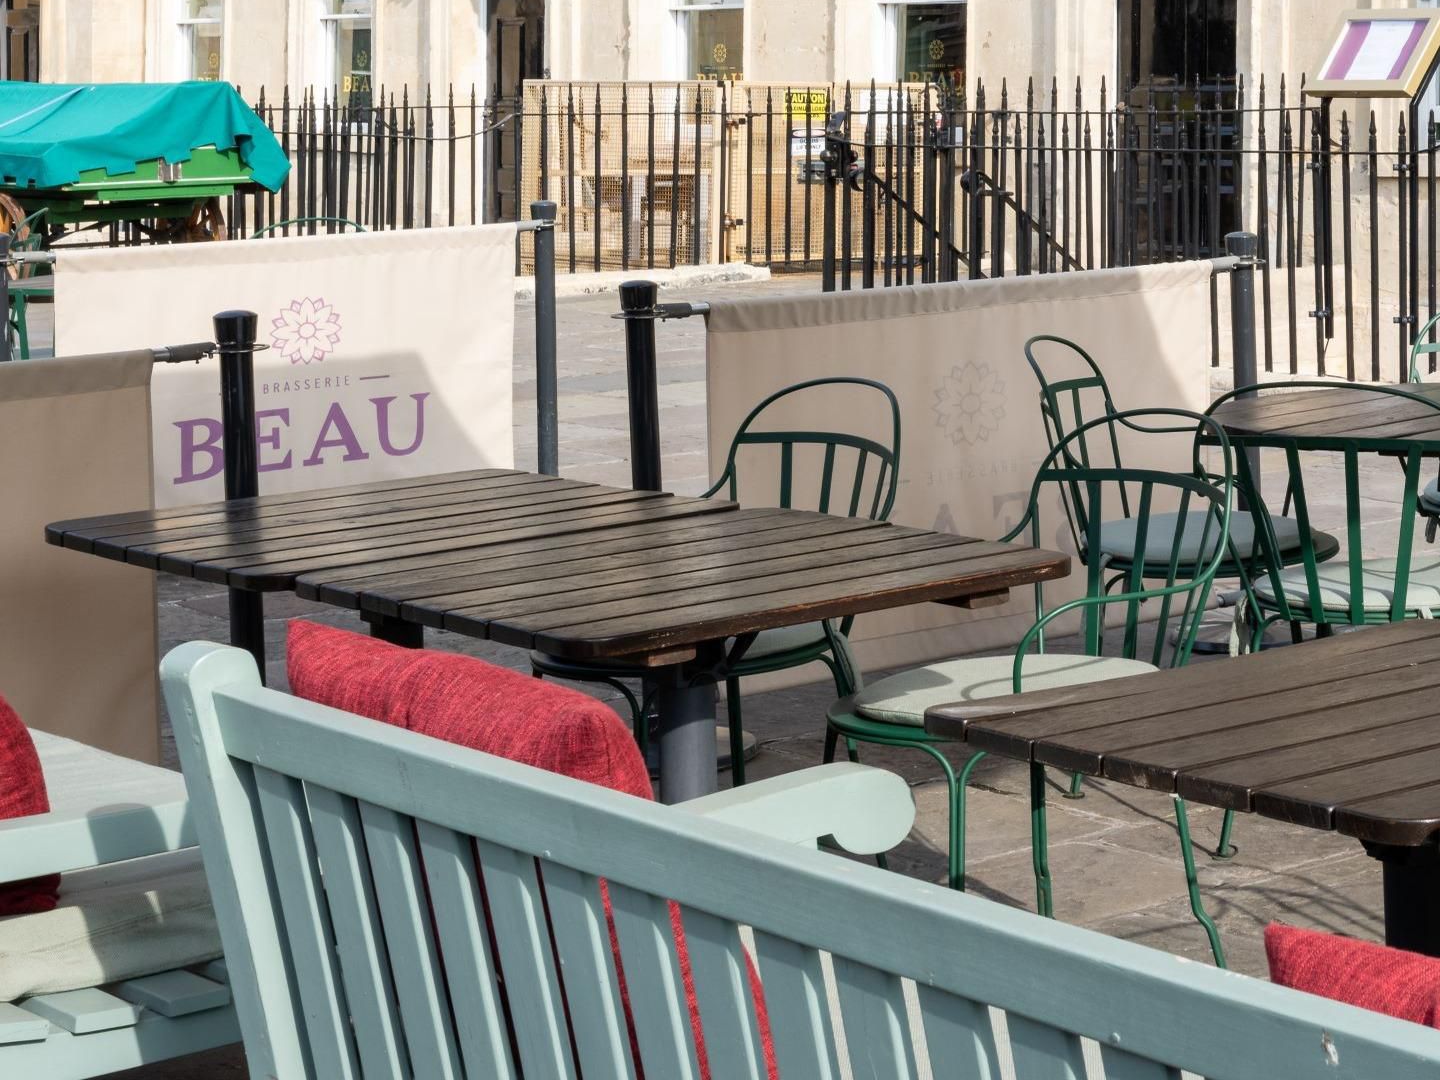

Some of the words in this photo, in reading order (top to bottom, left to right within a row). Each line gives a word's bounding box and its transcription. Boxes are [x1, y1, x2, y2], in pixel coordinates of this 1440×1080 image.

[786, 93, 824, 103] AUTON
[262, 374, 352, 394] BRASSERIE
[172, 392, 430, 485] BEAU
